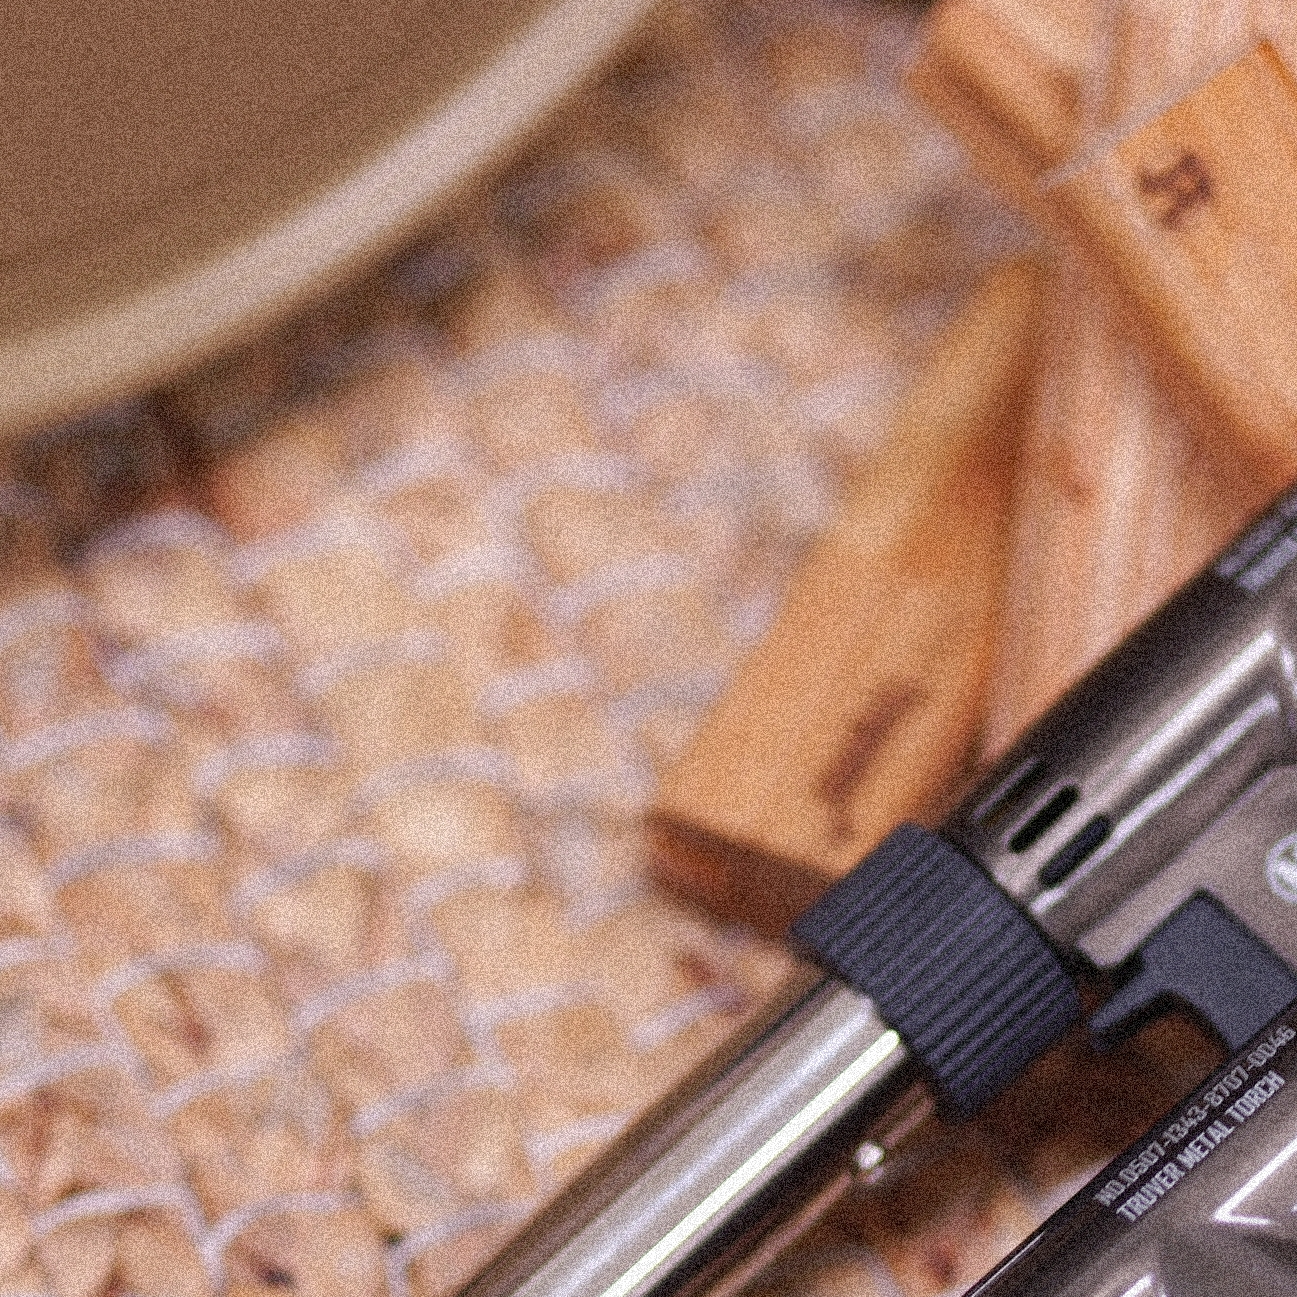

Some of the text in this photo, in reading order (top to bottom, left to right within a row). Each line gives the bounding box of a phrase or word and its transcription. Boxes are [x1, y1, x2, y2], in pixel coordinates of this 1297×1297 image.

[1116, 1070, 1285, 1222] TRUVER METAL TORCH
